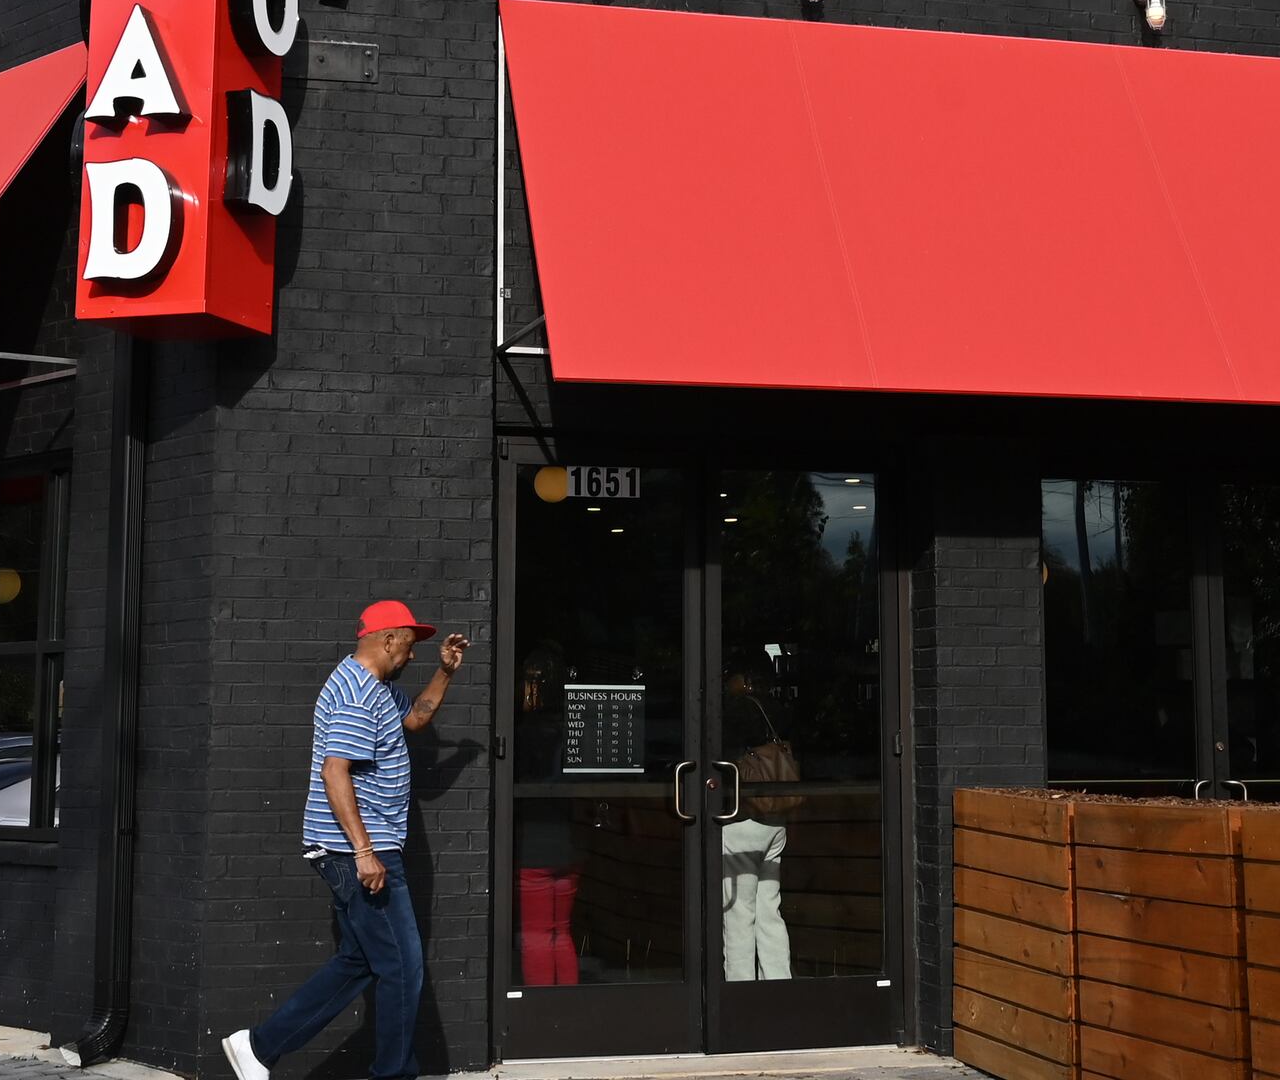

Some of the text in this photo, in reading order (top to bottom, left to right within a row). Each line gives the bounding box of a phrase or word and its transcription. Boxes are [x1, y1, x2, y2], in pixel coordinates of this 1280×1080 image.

[571, 467, 637, 497] 1651
[567, 691, 642, 701] BUSINESS HOURS
[567, 712, 581, 720] TUE
[567, 738, 579, 746] FRI
[567, 747, 580, 755] SAT
